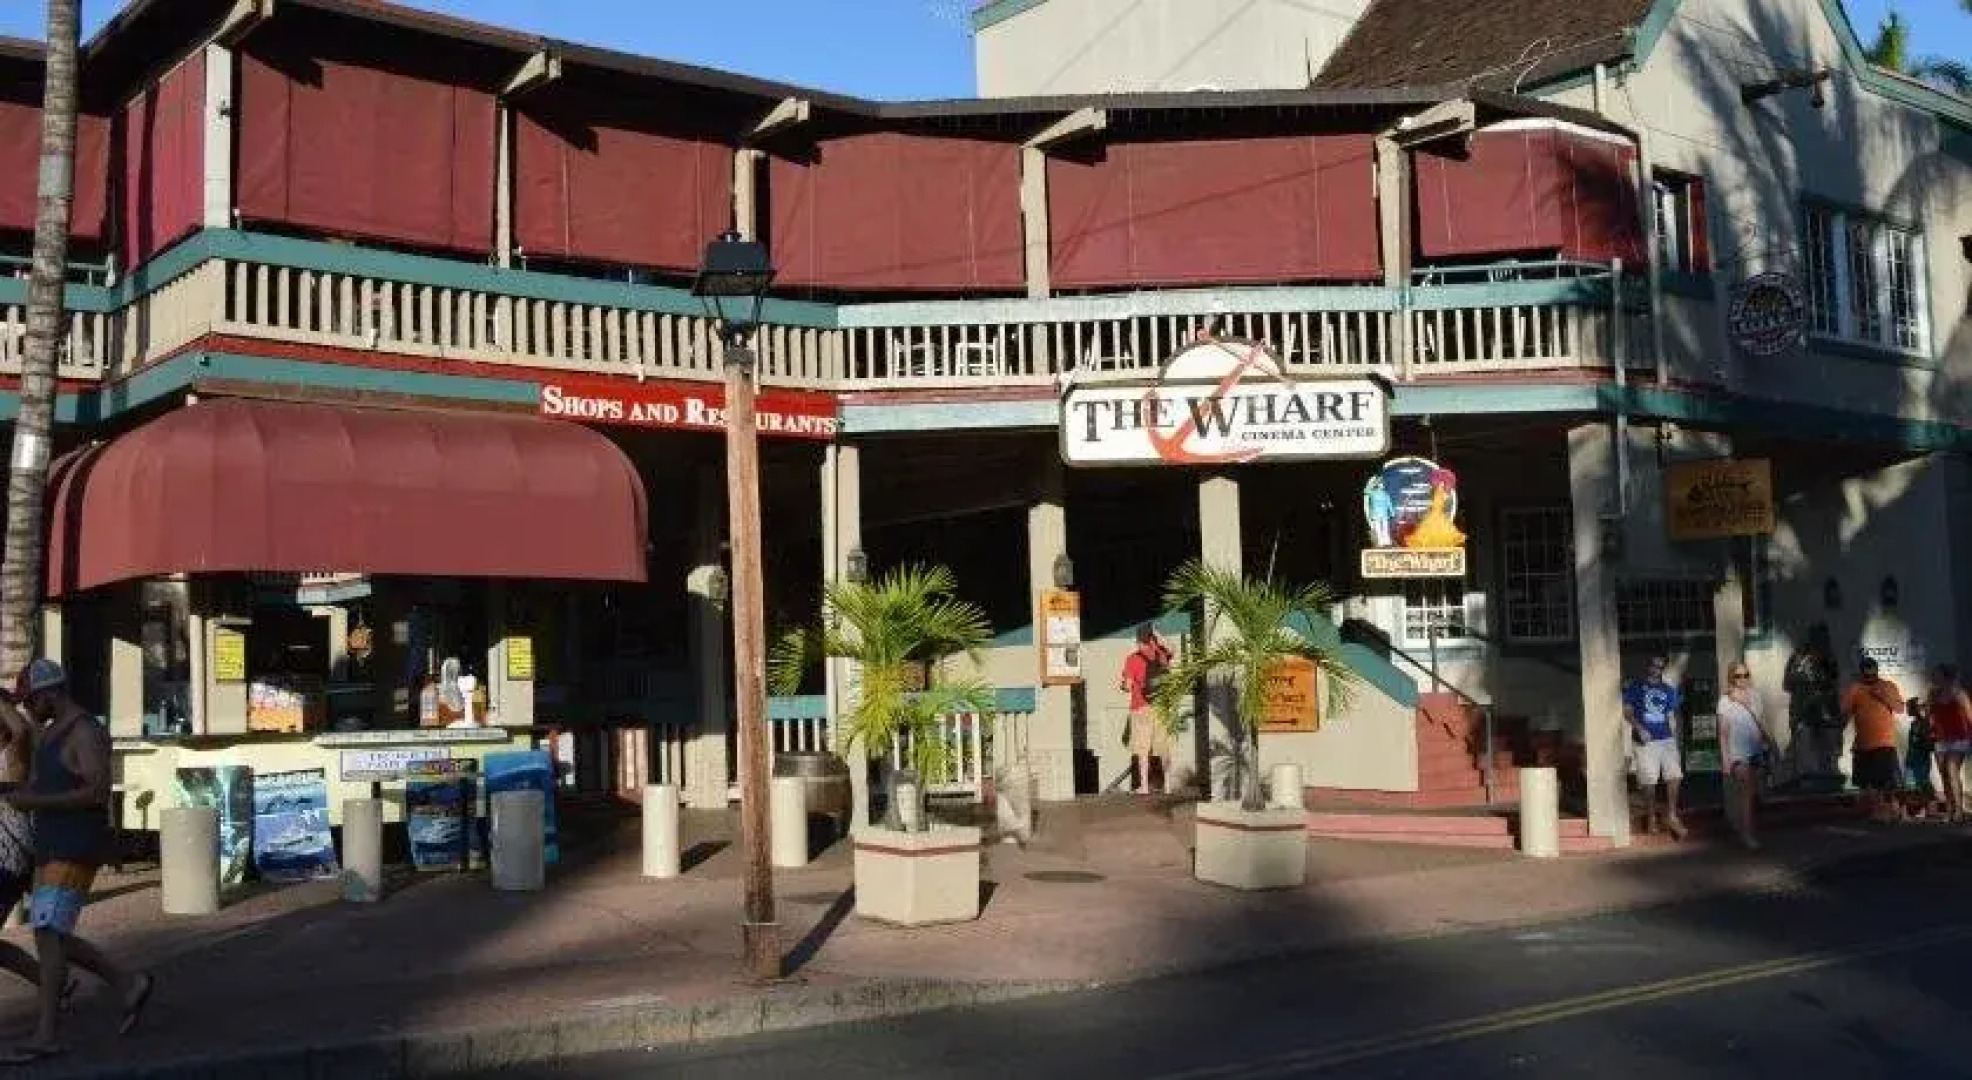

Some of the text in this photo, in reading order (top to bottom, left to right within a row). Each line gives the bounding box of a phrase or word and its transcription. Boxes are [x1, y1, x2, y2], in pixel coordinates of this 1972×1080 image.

[542, 384, 623, 419] SHOPS
[629, 401, 680, 423] AND
[1072, 391, 1374, 442] THE WHARF
[1241, 427, 1376, 441] CINEMA CENTER
